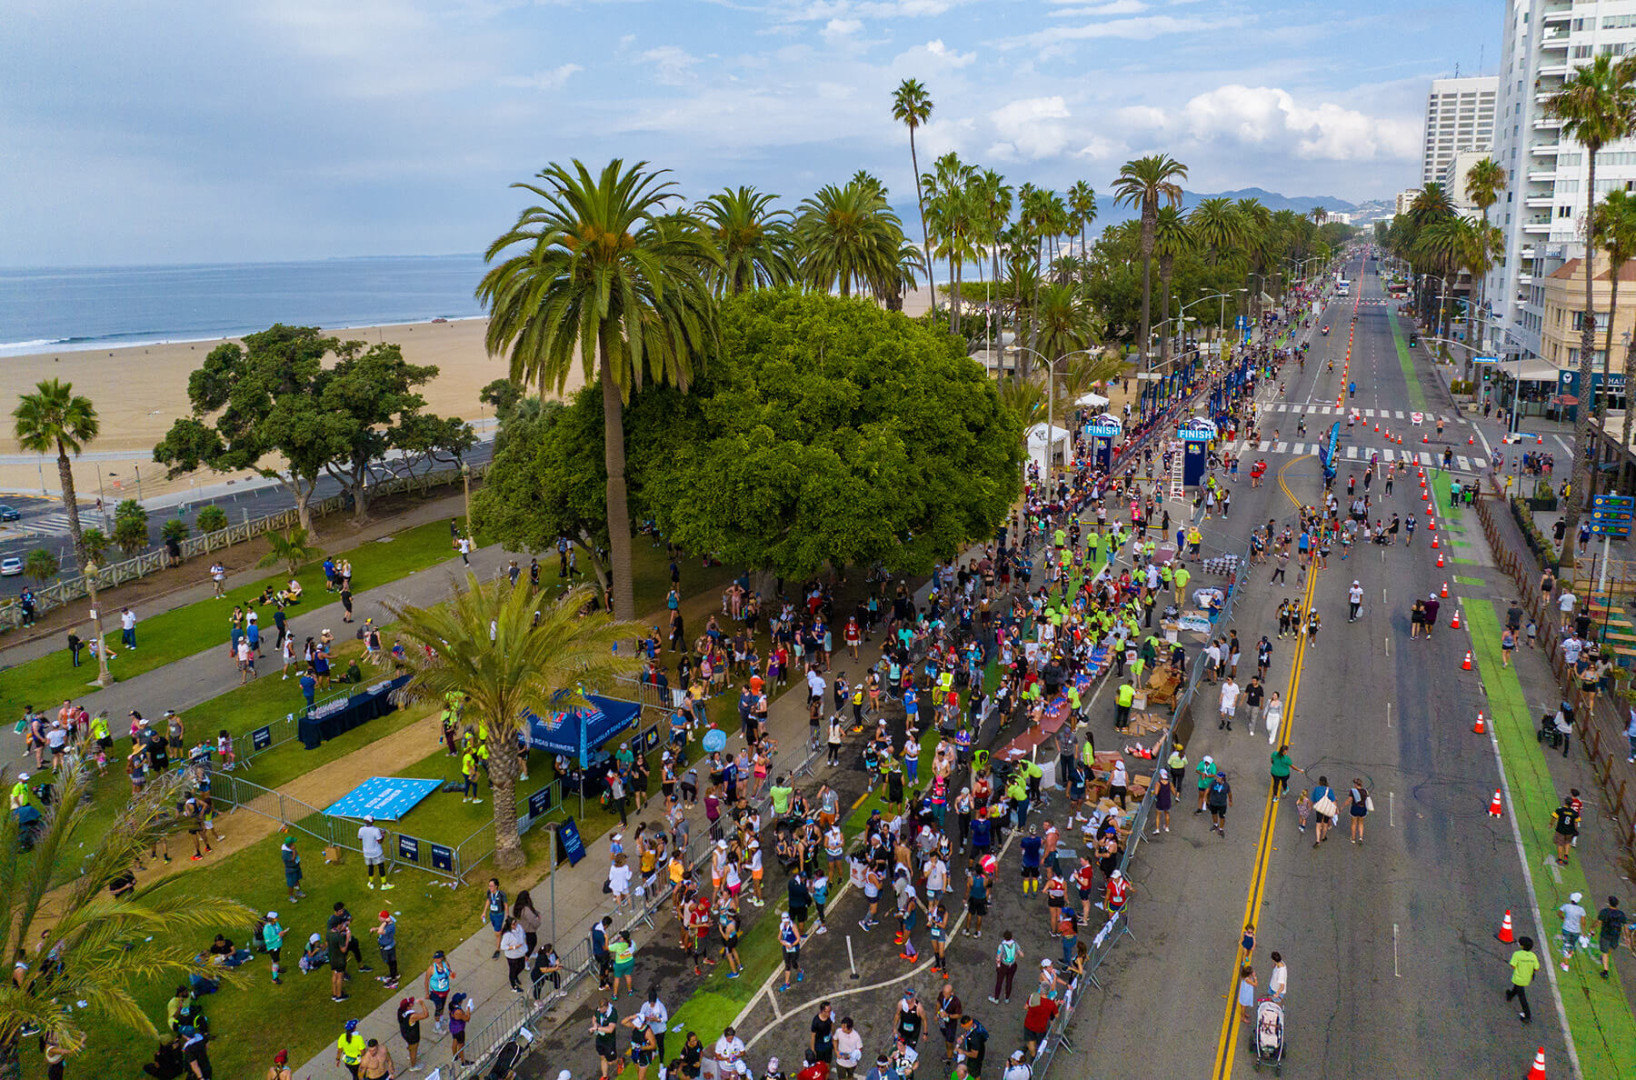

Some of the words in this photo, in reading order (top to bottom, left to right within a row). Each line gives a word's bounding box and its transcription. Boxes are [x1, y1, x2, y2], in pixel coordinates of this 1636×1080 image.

[1087, 425, 1118, 435] FINISH
[1179, 430, 1212, 439] FINISH
[534, 738, 549, 747] ROAD
[549, 742, 575, 752] RUNNERS
